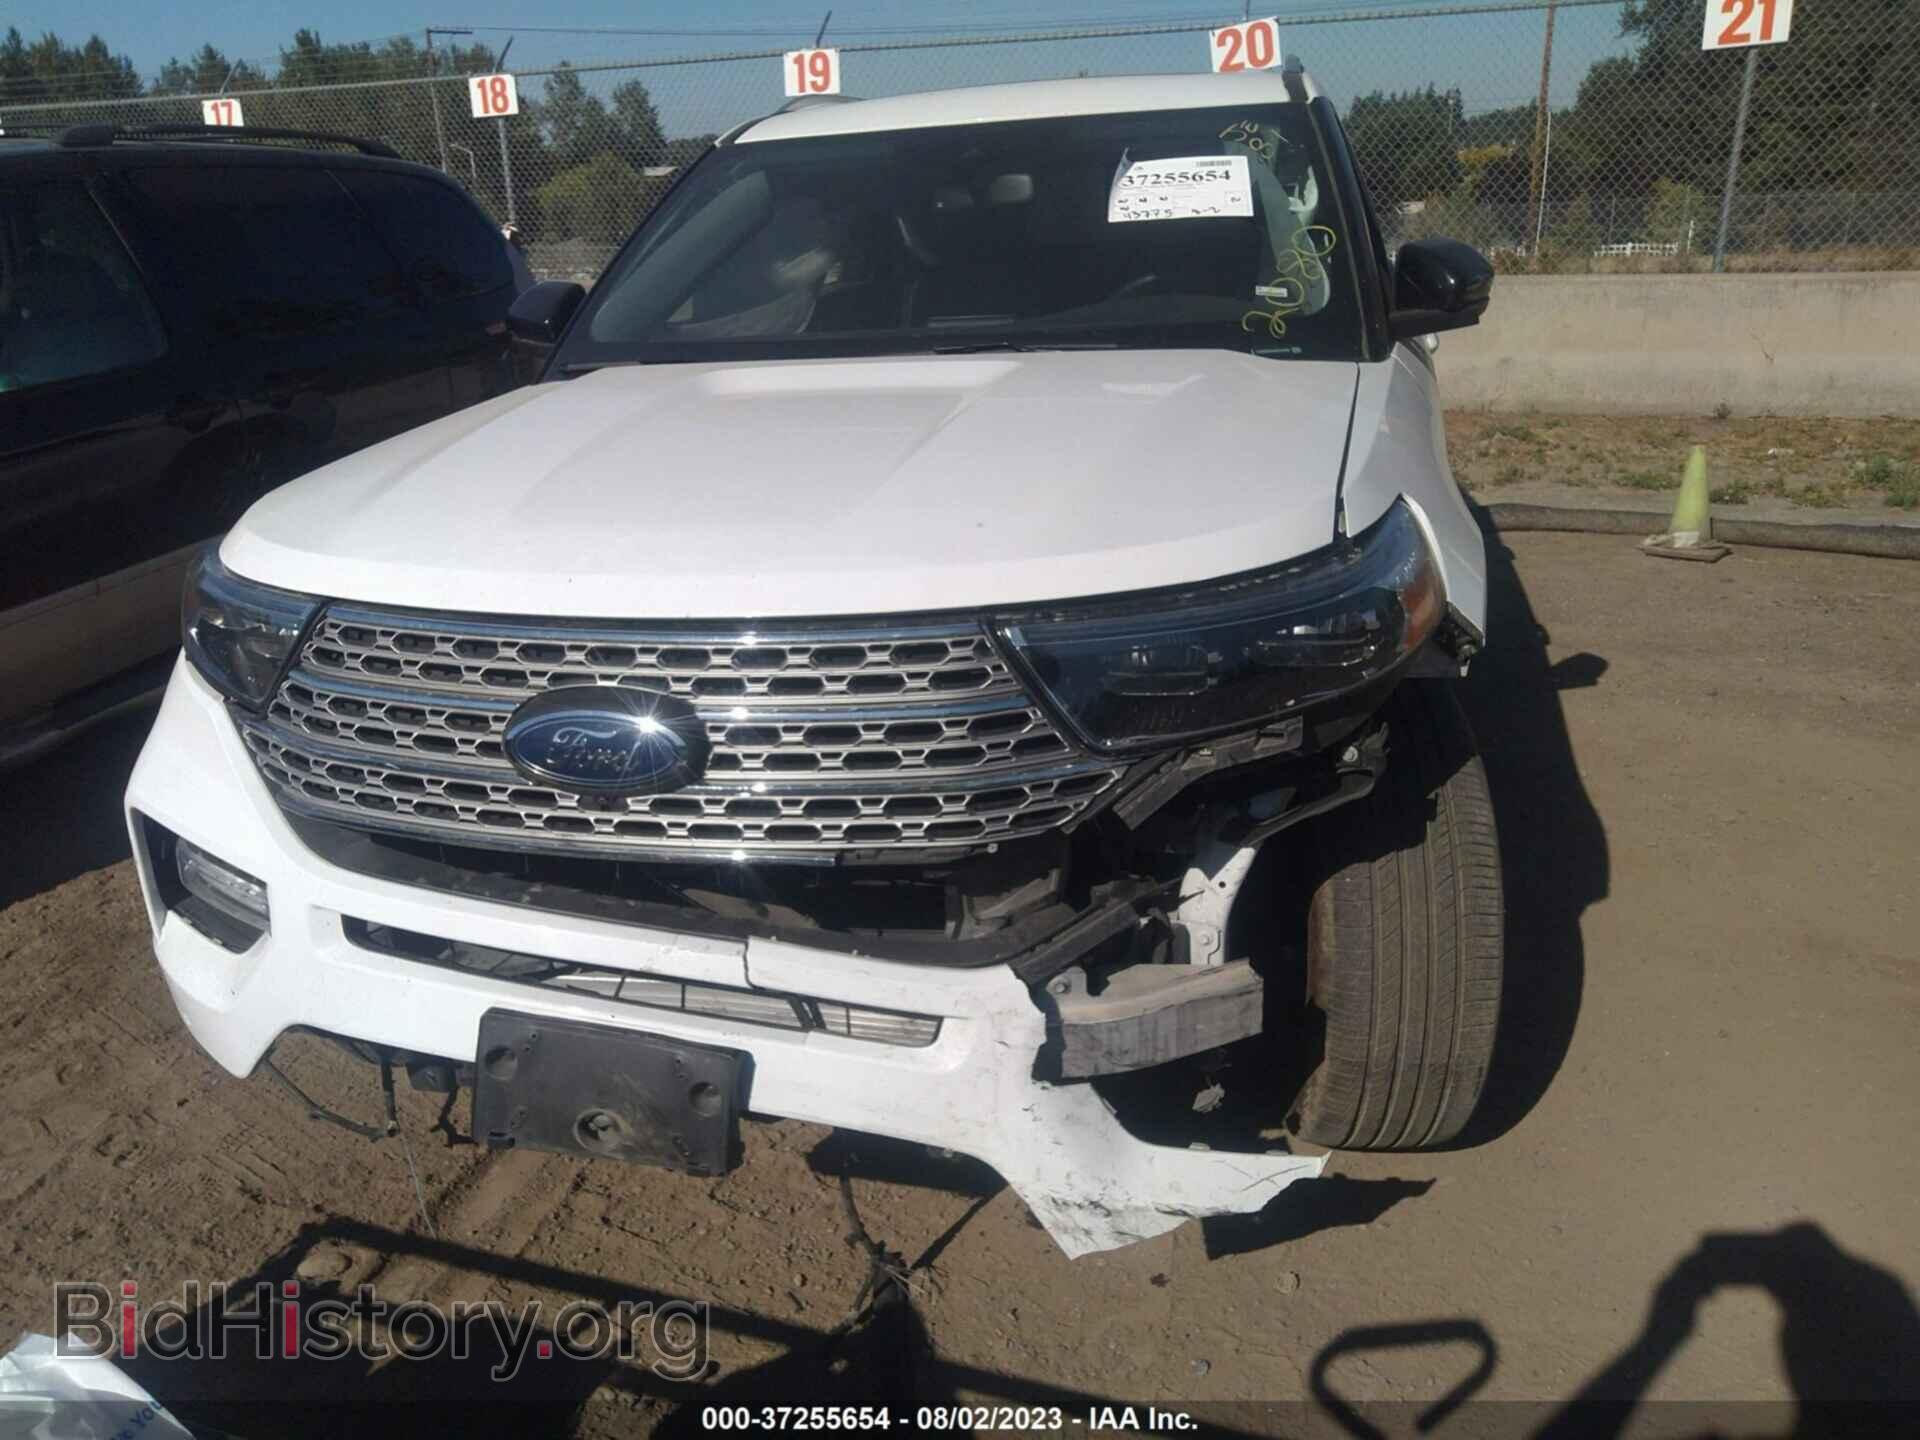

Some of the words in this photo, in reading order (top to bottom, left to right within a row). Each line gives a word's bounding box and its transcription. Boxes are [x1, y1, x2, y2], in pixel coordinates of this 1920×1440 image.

[1717, 0, 1777, 46] 21
[1215, 20, 1274, 73] 20
[792, 51, 832, 93] 19
[211, 101, 234, 127] 17
[477, 77, 511, 115] 18
[1119, 169, 1232, 188] 37255654
[549, 725, 644, 773] Ford
